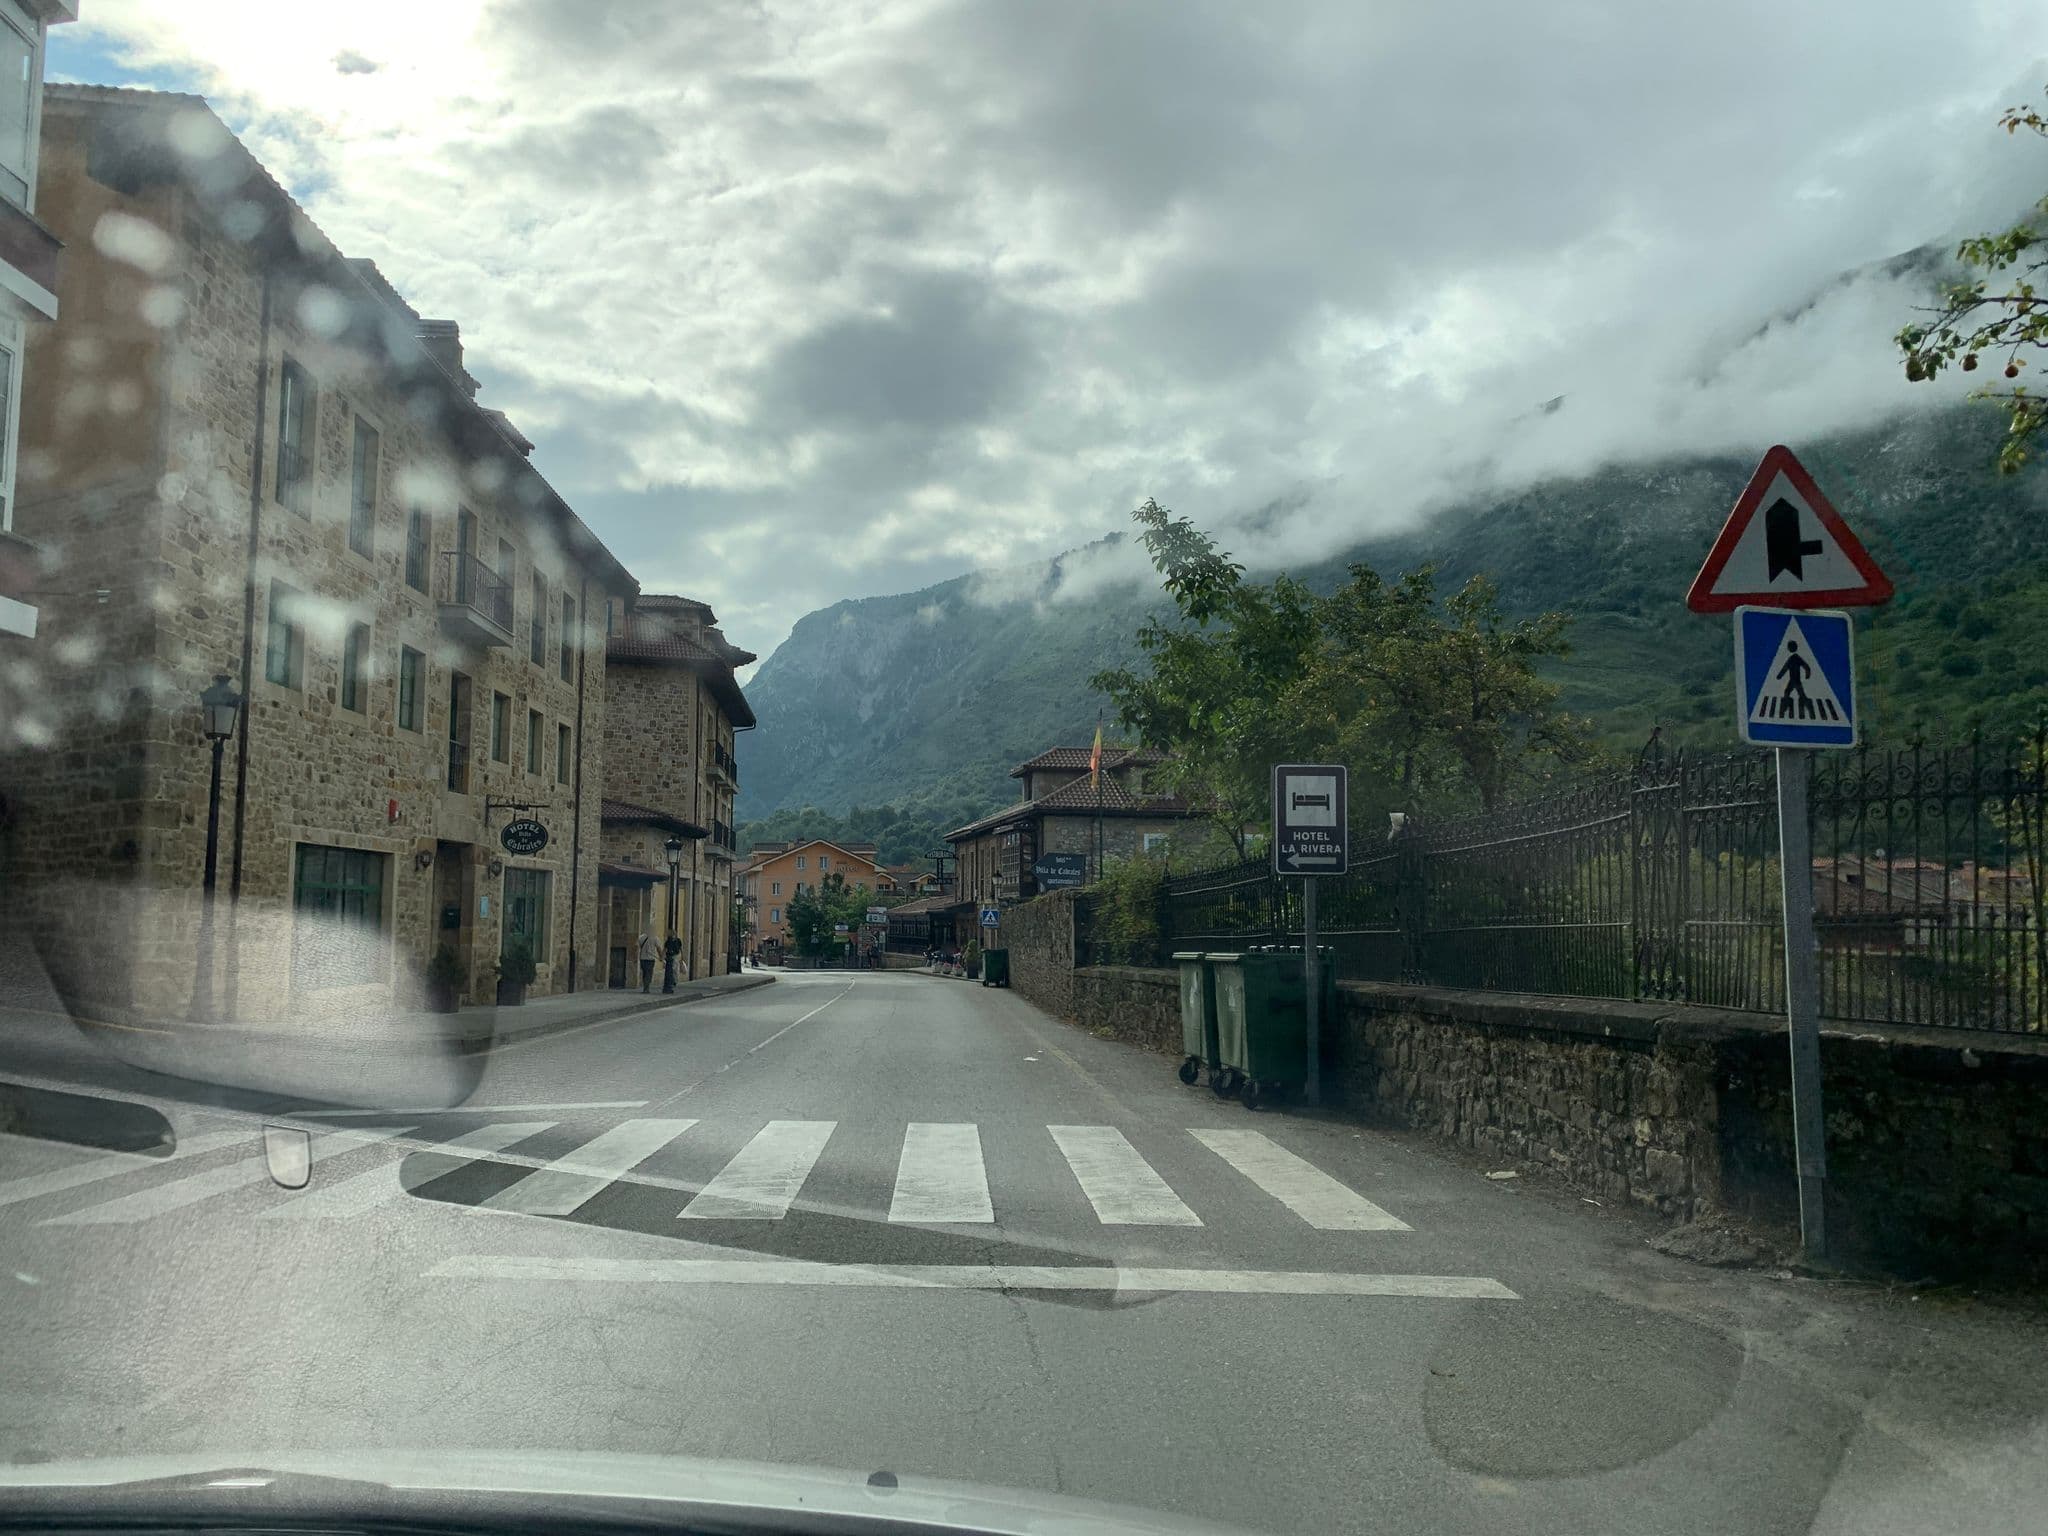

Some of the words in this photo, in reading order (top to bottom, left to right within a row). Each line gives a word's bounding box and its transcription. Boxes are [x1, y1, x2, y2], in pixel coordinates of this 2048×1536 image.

[509, 823, 540, 834] HOTEL
[1293, 831, 1330, 841] HOTEL
[507, 838, 542, 851] Cabrales
[1281, 844, 1296, 853] LA
[1301, 844, 1342, 853] RIVERA
[1058, 867, 1081, 876] Cabrales
